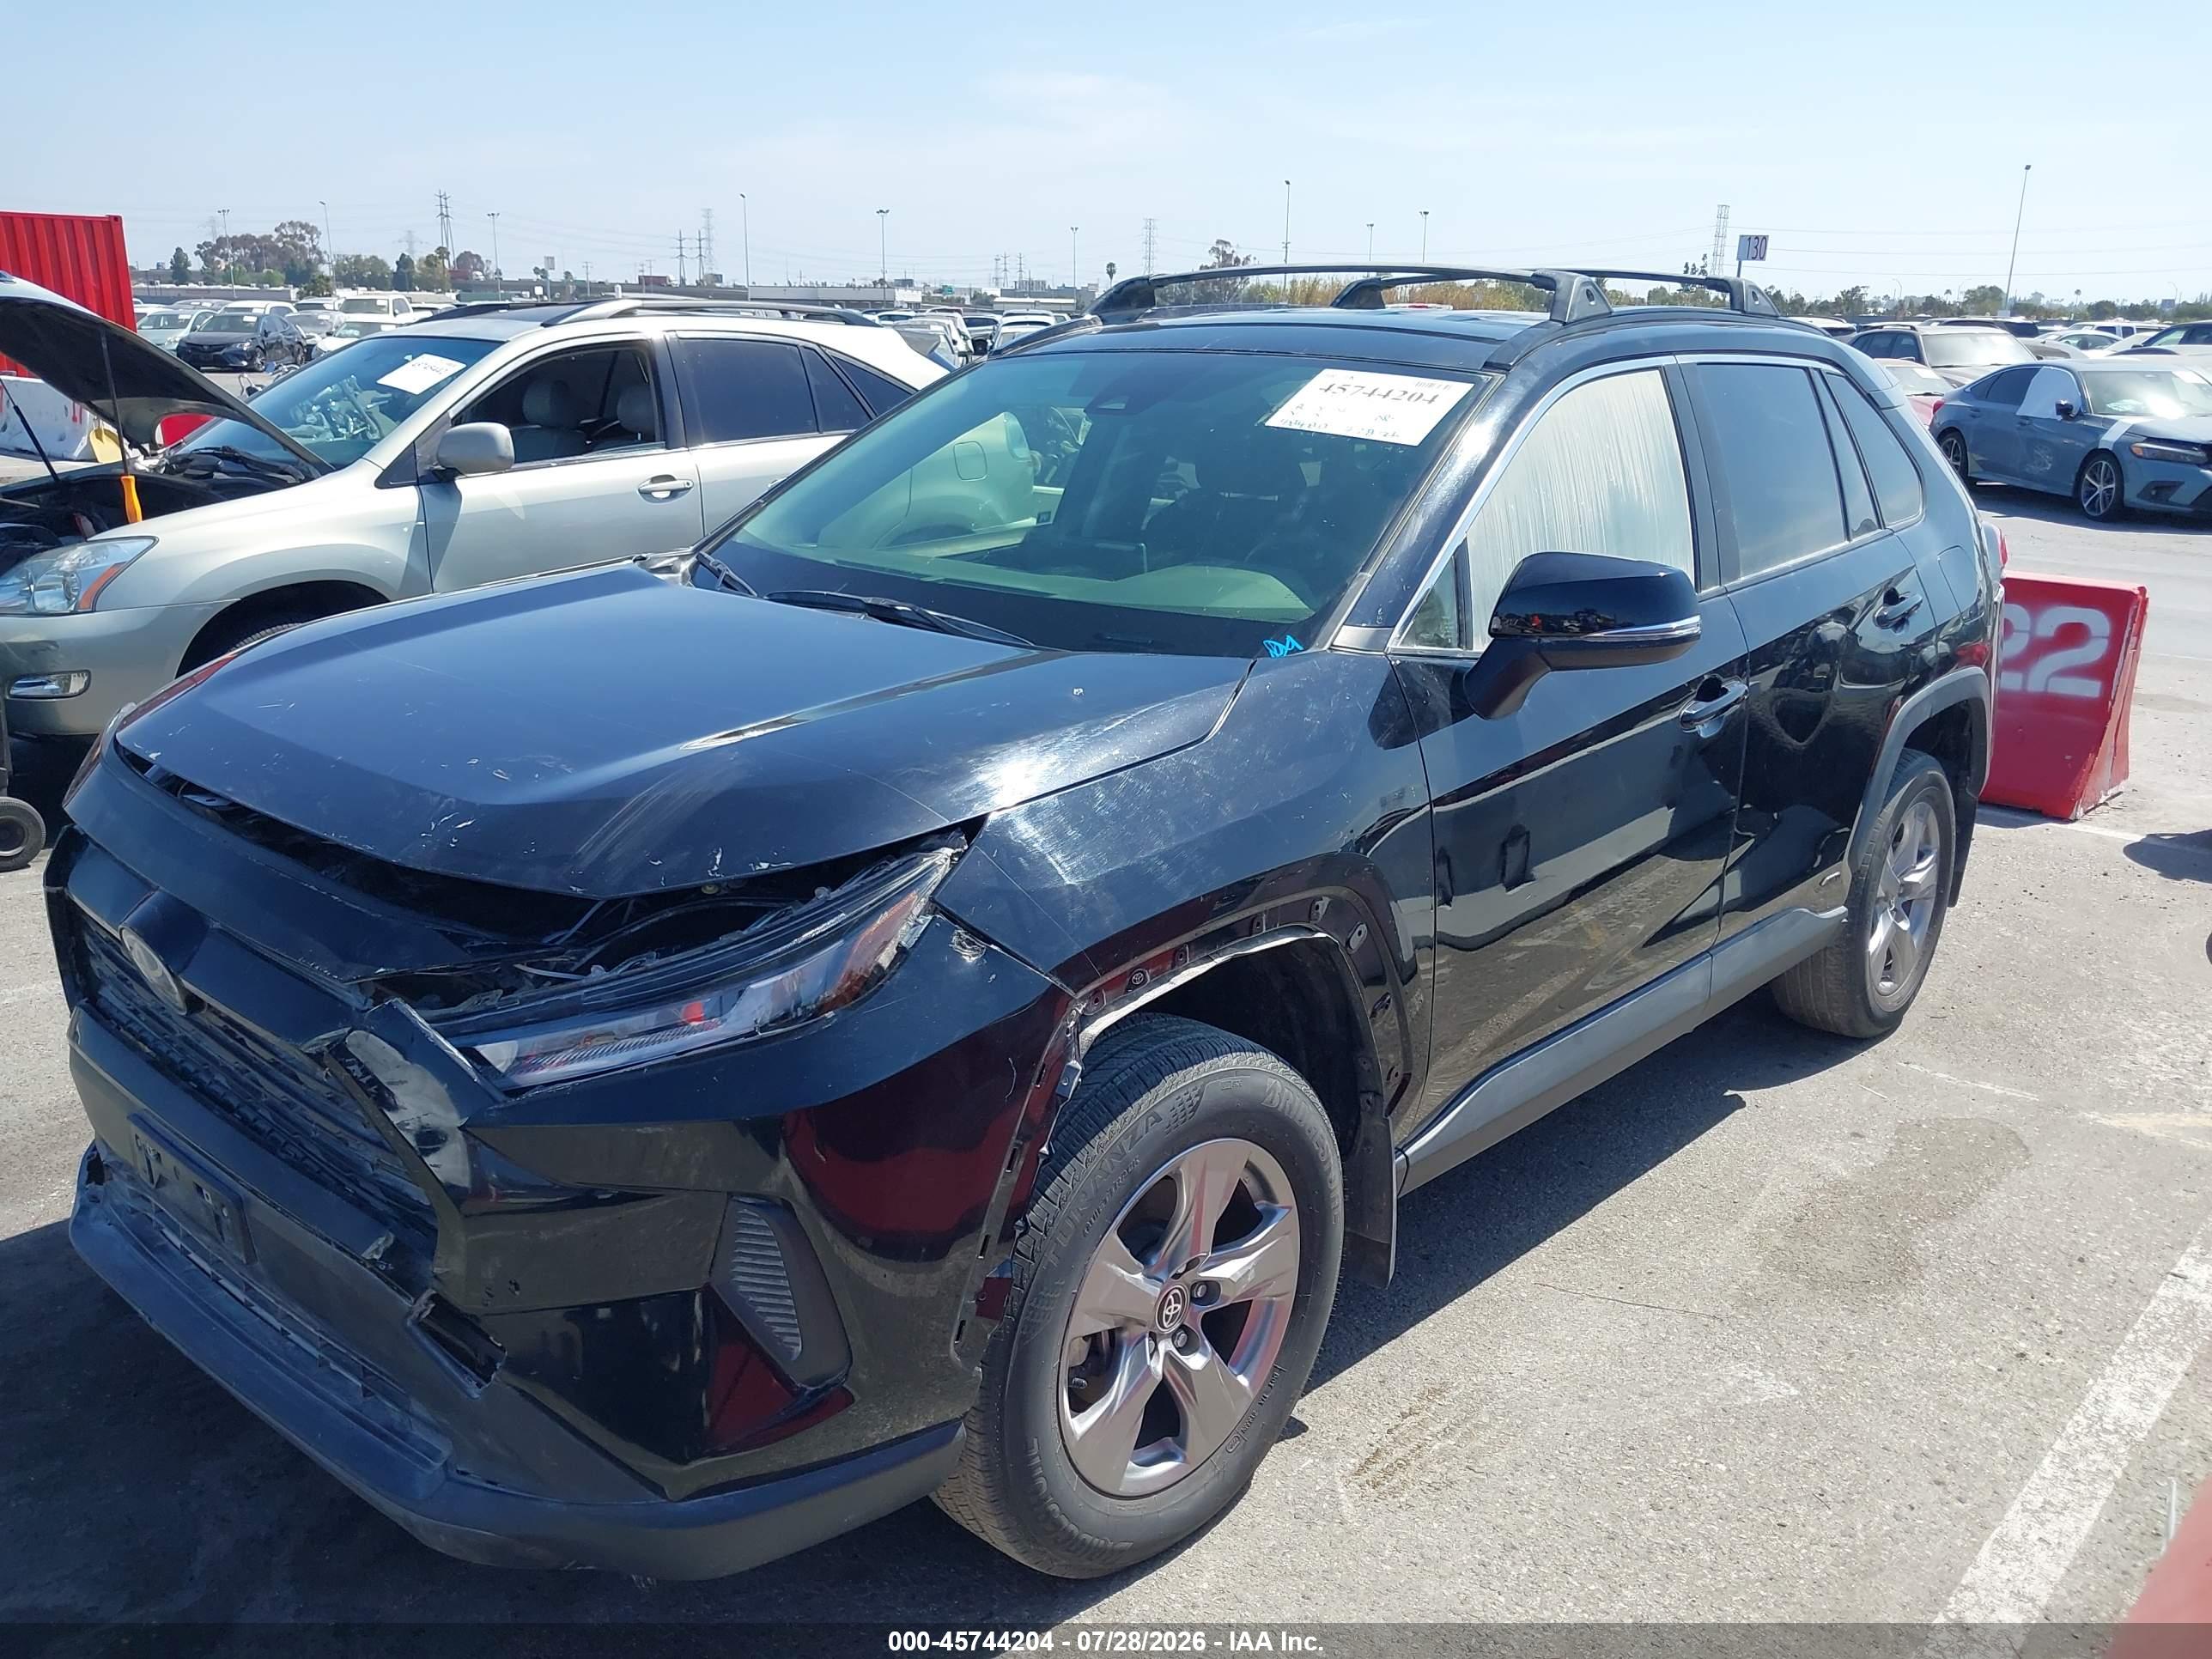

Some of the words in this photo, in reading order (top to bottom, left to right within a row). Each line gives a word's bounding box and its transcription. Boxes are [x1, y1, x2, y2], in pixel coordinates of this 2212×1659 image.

[1746, 236, 1766, 259] 130
[1319, 383, 1439, 404] 45744204
[1048, 1109, 1164, 1269] TURANZA
